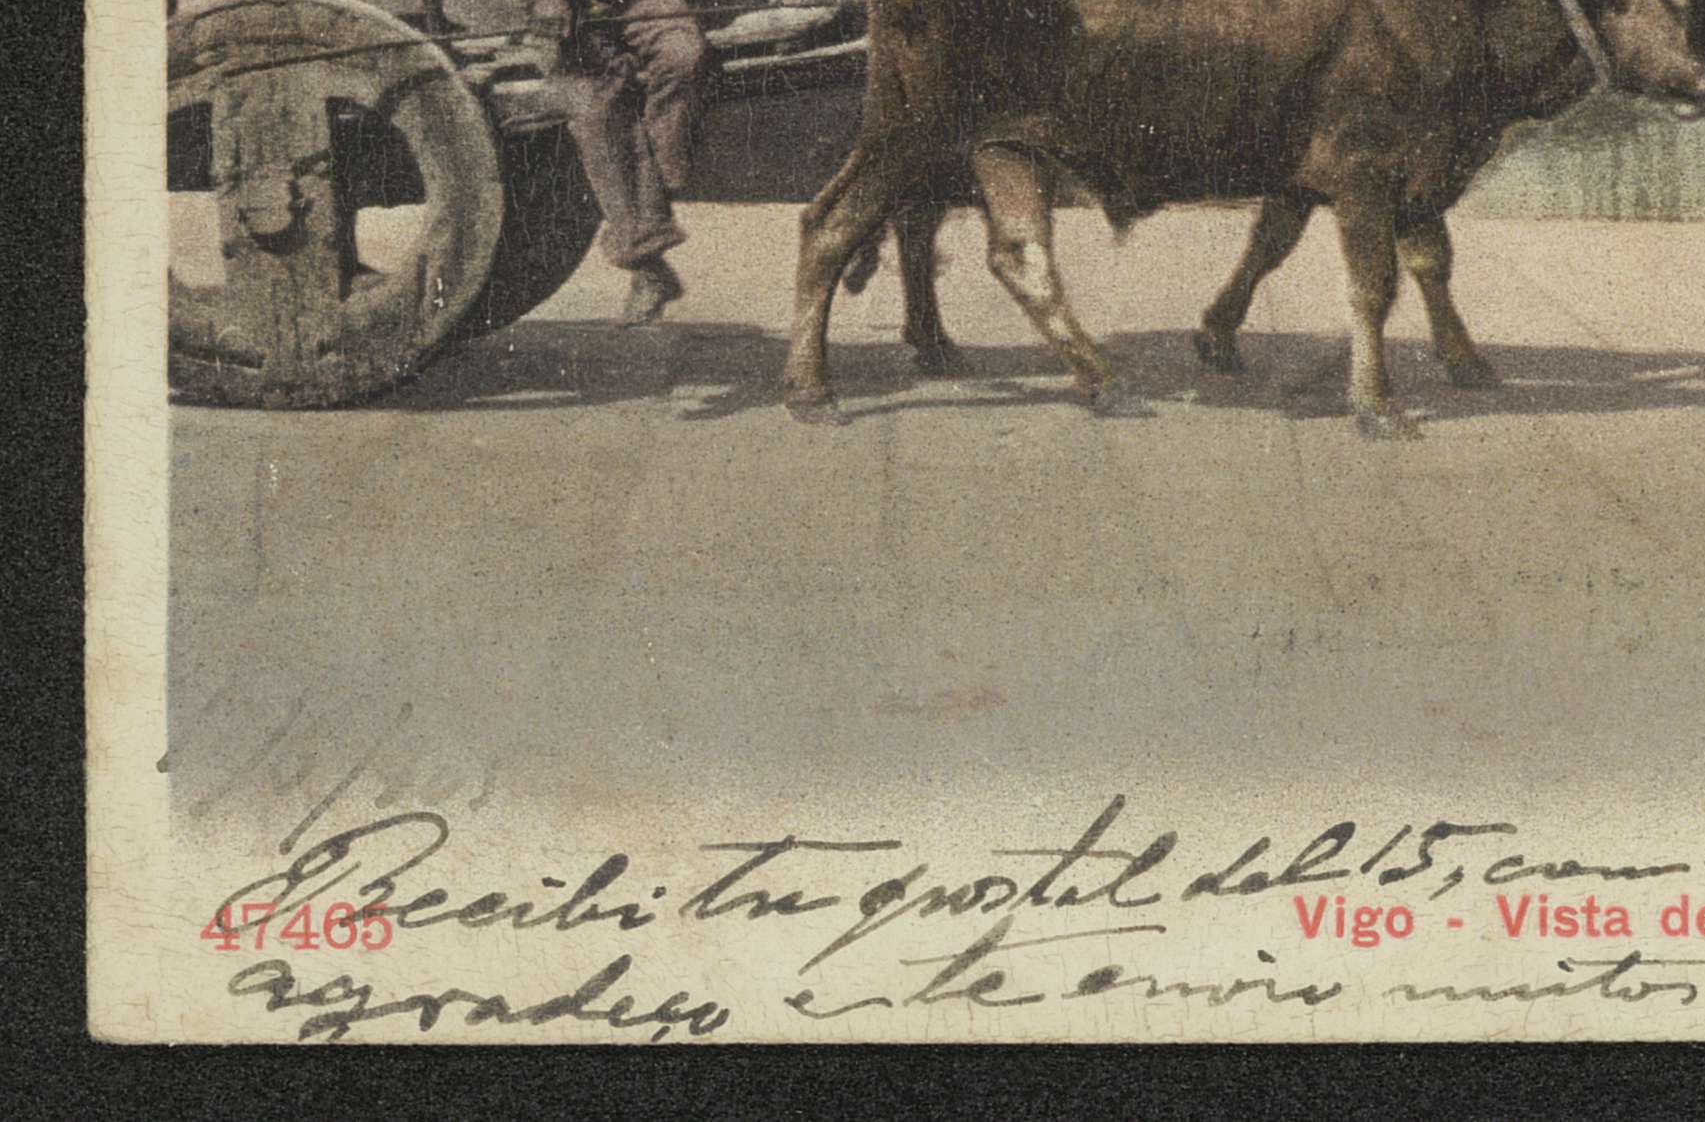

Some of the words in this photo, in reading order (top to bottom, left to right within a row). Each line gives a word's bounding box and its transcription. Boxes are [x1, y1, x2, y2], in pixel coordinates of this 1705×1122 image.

[798, 793, 1180, 975] postal
[1181, 821, 1356, 901] del
[199, 901, 395, 953] 47465
[1292, 893, 1416, 949] Vigo
[1495, 891, 1634, 939] Vista
